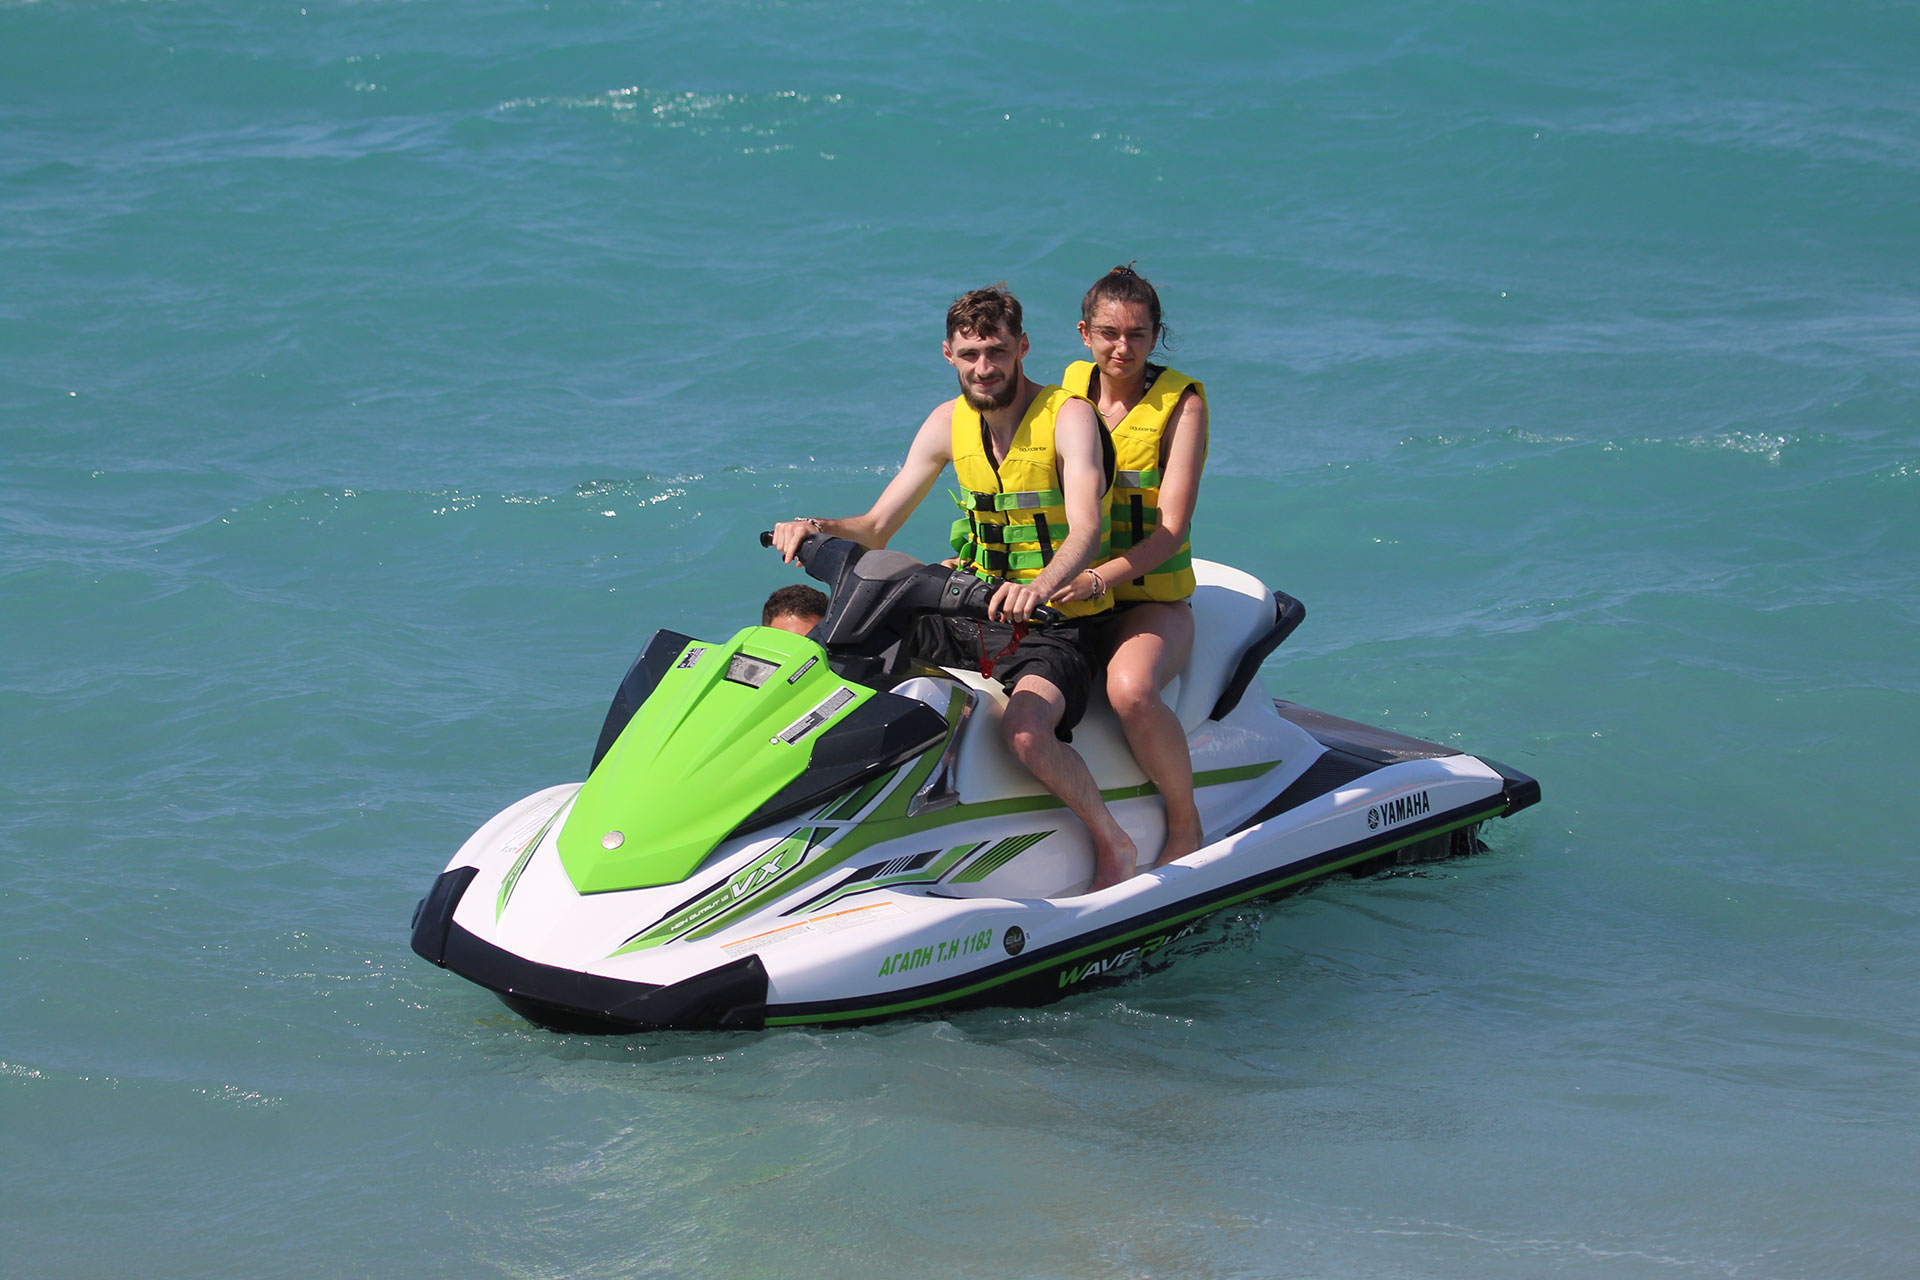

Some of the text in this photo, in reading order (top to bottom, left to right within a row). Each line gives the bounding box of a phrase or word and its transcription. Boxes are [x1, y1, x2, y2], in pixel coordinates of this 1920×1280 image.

[1380, 790, 1430, 827] YAMAHA
[731, 849, 787, 899] VX
[688, 899, 721, 921] OUTPUT
[963, 928, 993, 956] 1183
